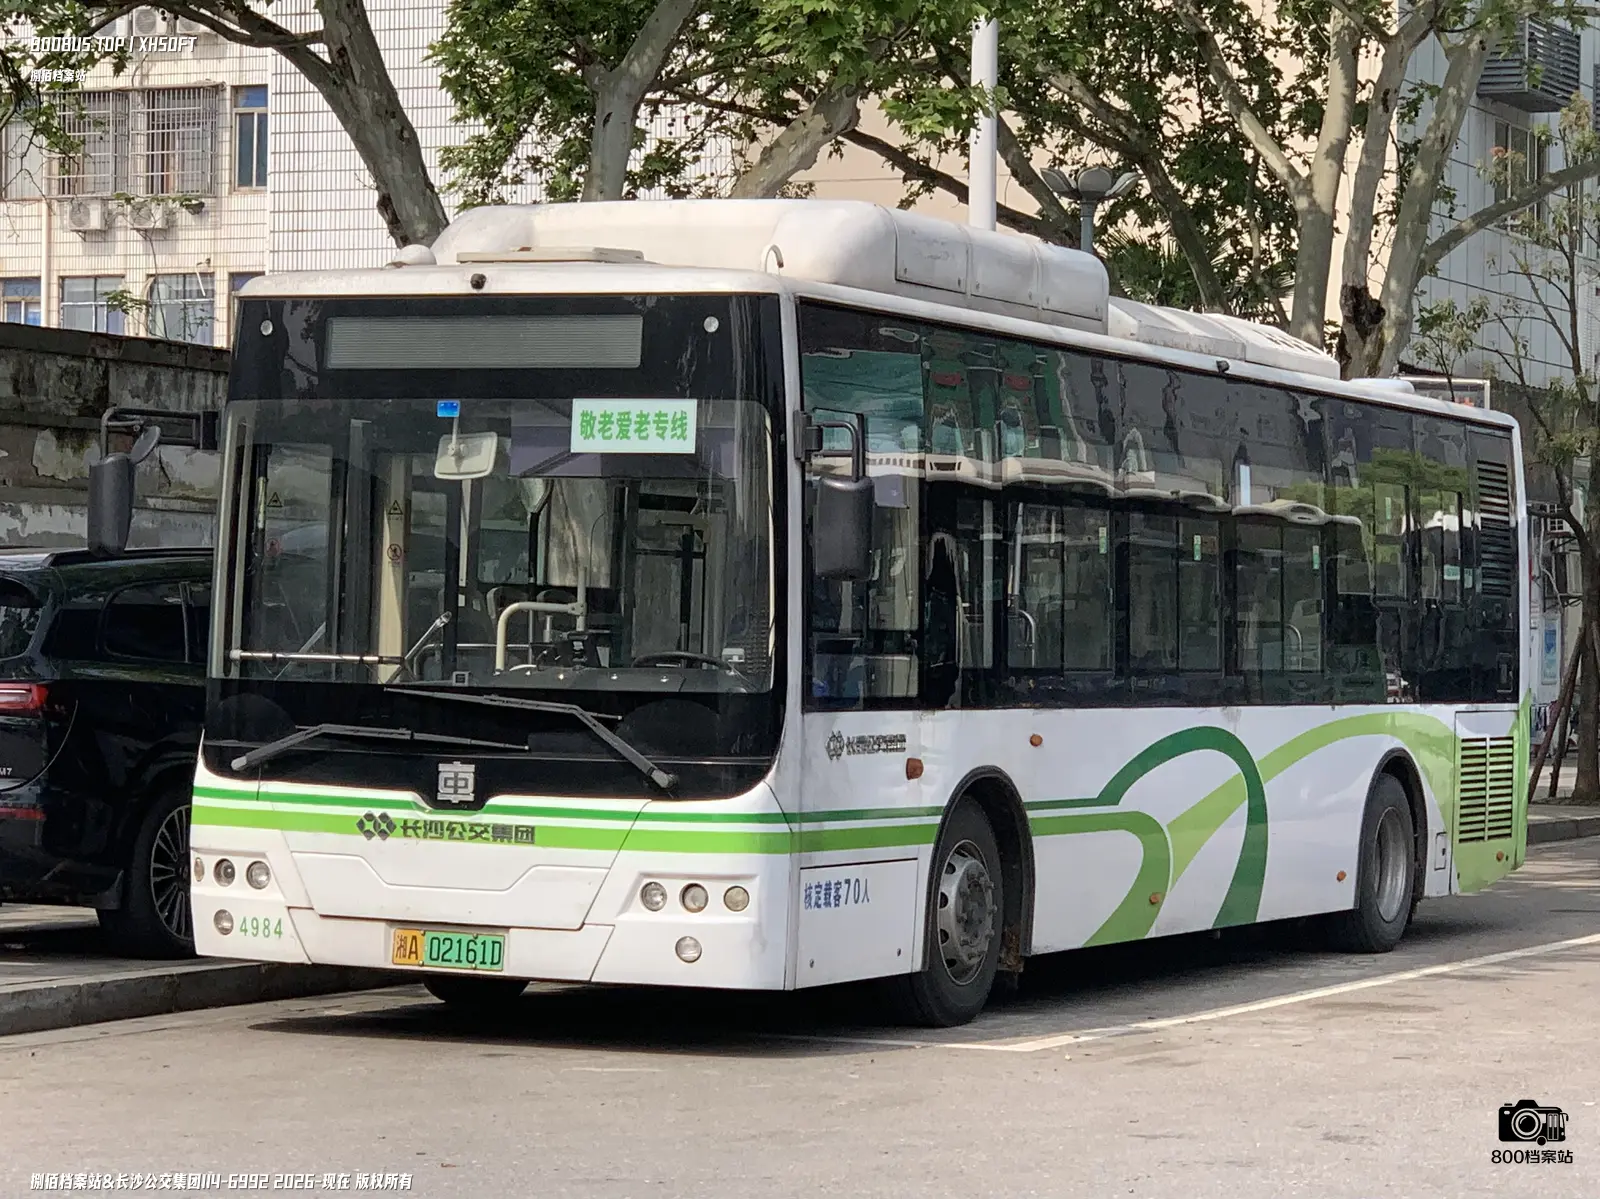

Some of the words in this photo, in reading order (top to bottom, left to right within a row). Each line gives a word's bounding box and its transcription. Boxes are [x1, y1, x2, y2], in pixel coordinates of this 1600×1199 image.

[580, 410, 688, 441] 敬老爱老专线
[400, 819, 536, 844] 长沙公交集团
[239, 916, 283, 939] 4984
[429, 936, 502, 965] 02161D
